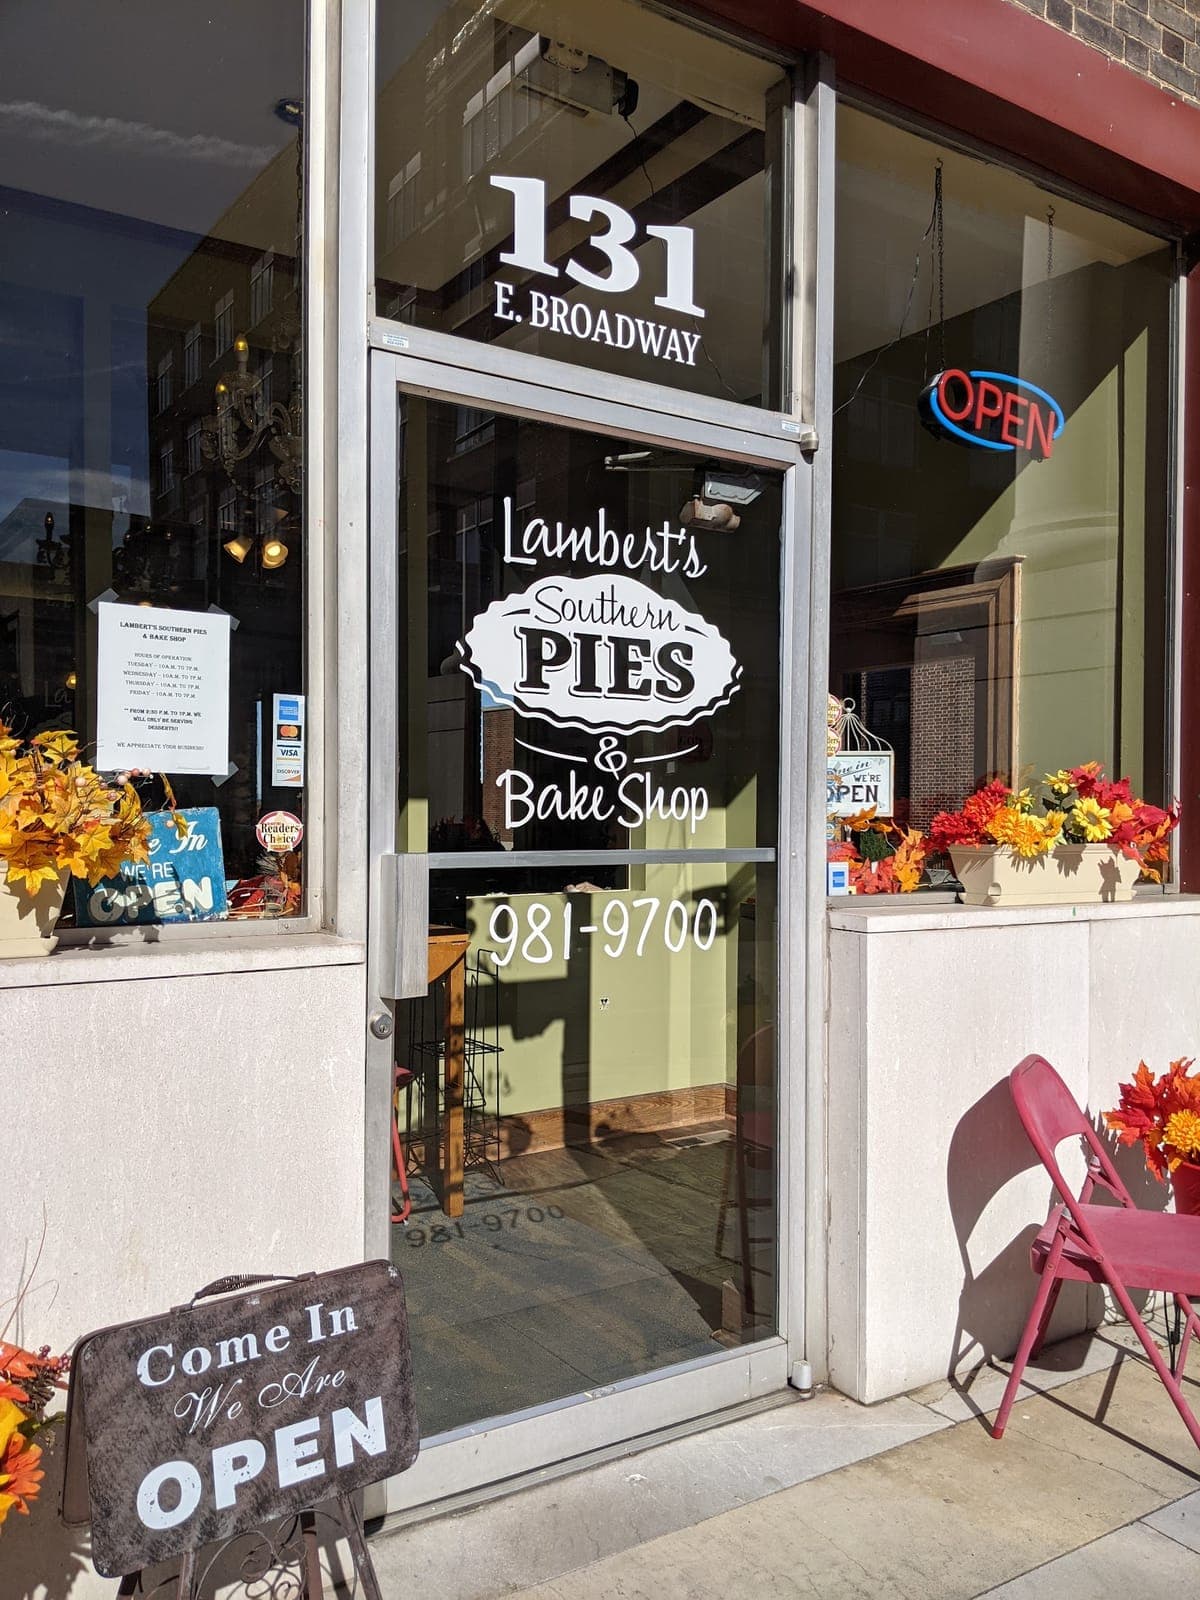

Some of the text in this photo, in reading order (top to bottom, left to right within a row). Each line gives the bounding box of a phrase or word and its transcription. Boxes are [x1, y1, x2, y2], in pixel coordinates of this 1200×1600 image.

[490, 175, 705, 318] 131
[493, 280, 702, 367] E. BROADWAY
[937, 369, 1056, 459] OPEN
[503, 496, 708, 579] Lambert's
[120, 621, 208, 636] LAMBERT'S SOUTHERN PIES
[534, 584, 681, 632] Southern
[514, 625, 697, 702] PIES
[280, 749, 299, 757] VISA
[594, 736, 628, 780] &
[853, 772, 882, 783] WE'RE
[496, 768, 709, 834] Bake Shop
[88, 876, 215, 923] OPEN
[119, 861, 174, 882] WE'RE
[489, 897, 718, 966] 981-9700
[136, 1302, 359, 1388] Come In
[173, 1355, 346, 1434] We Are
[136, 1396, 387, 1531] OPEN
